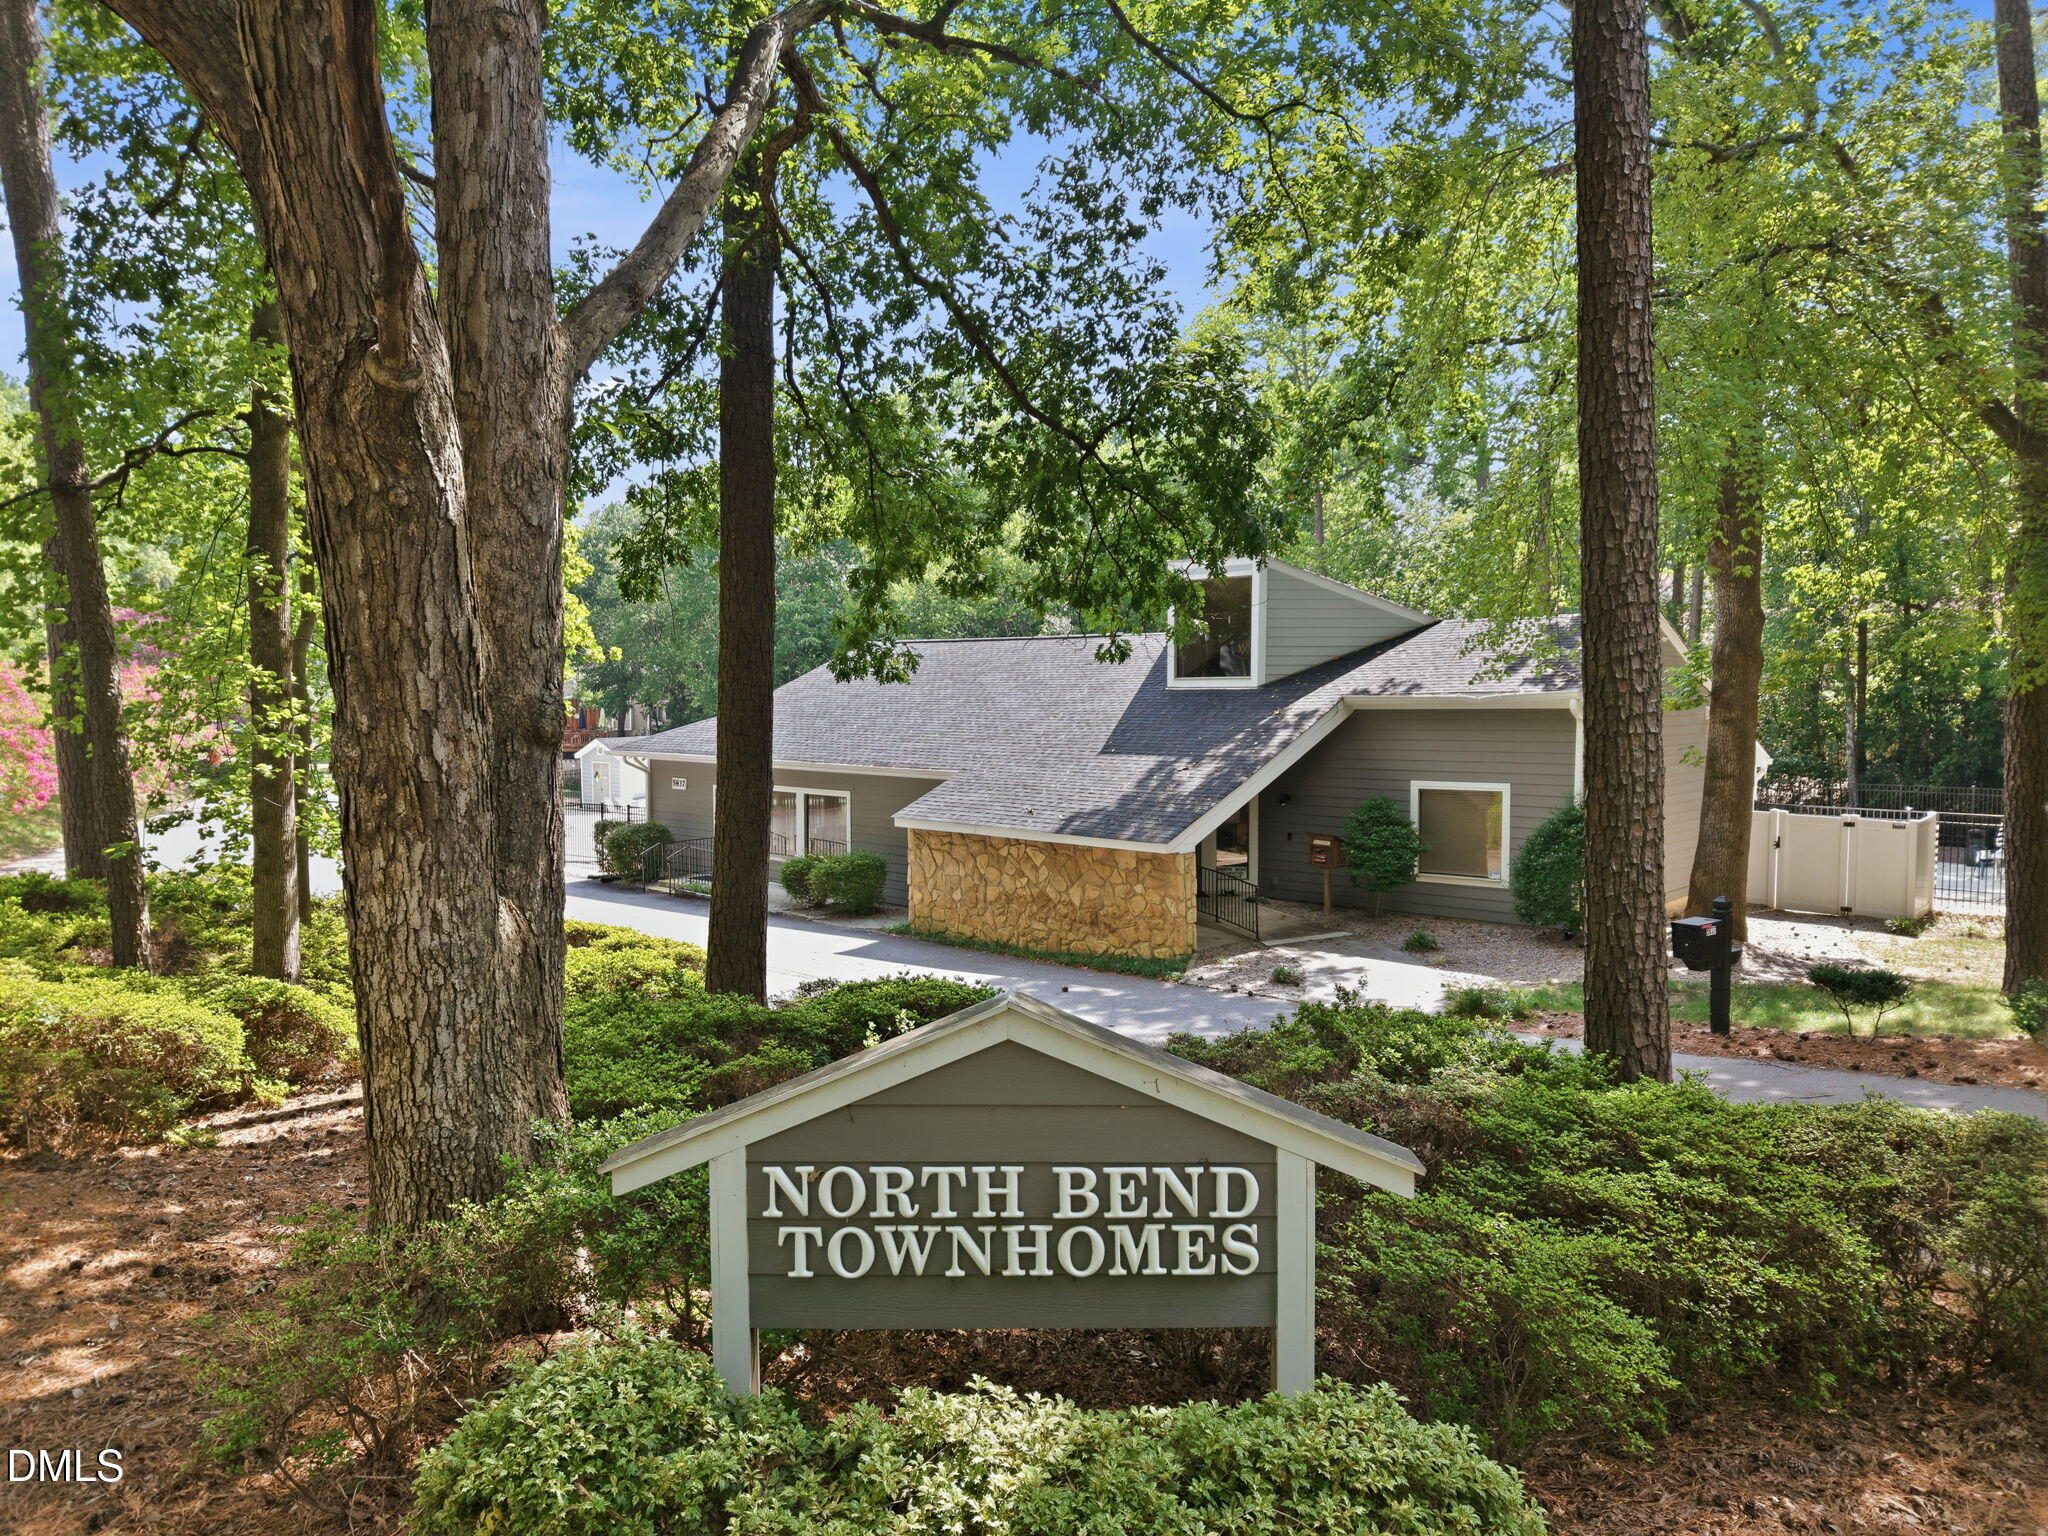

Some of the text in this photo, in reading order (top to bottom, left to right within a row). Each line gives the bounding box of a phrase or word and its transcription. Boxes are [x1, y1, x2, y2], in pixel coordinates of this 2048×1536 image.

[762, 1165, 1260, 1218] NORTH BEND
[777, 1223, 1260, 1278] TOWNHOMES
